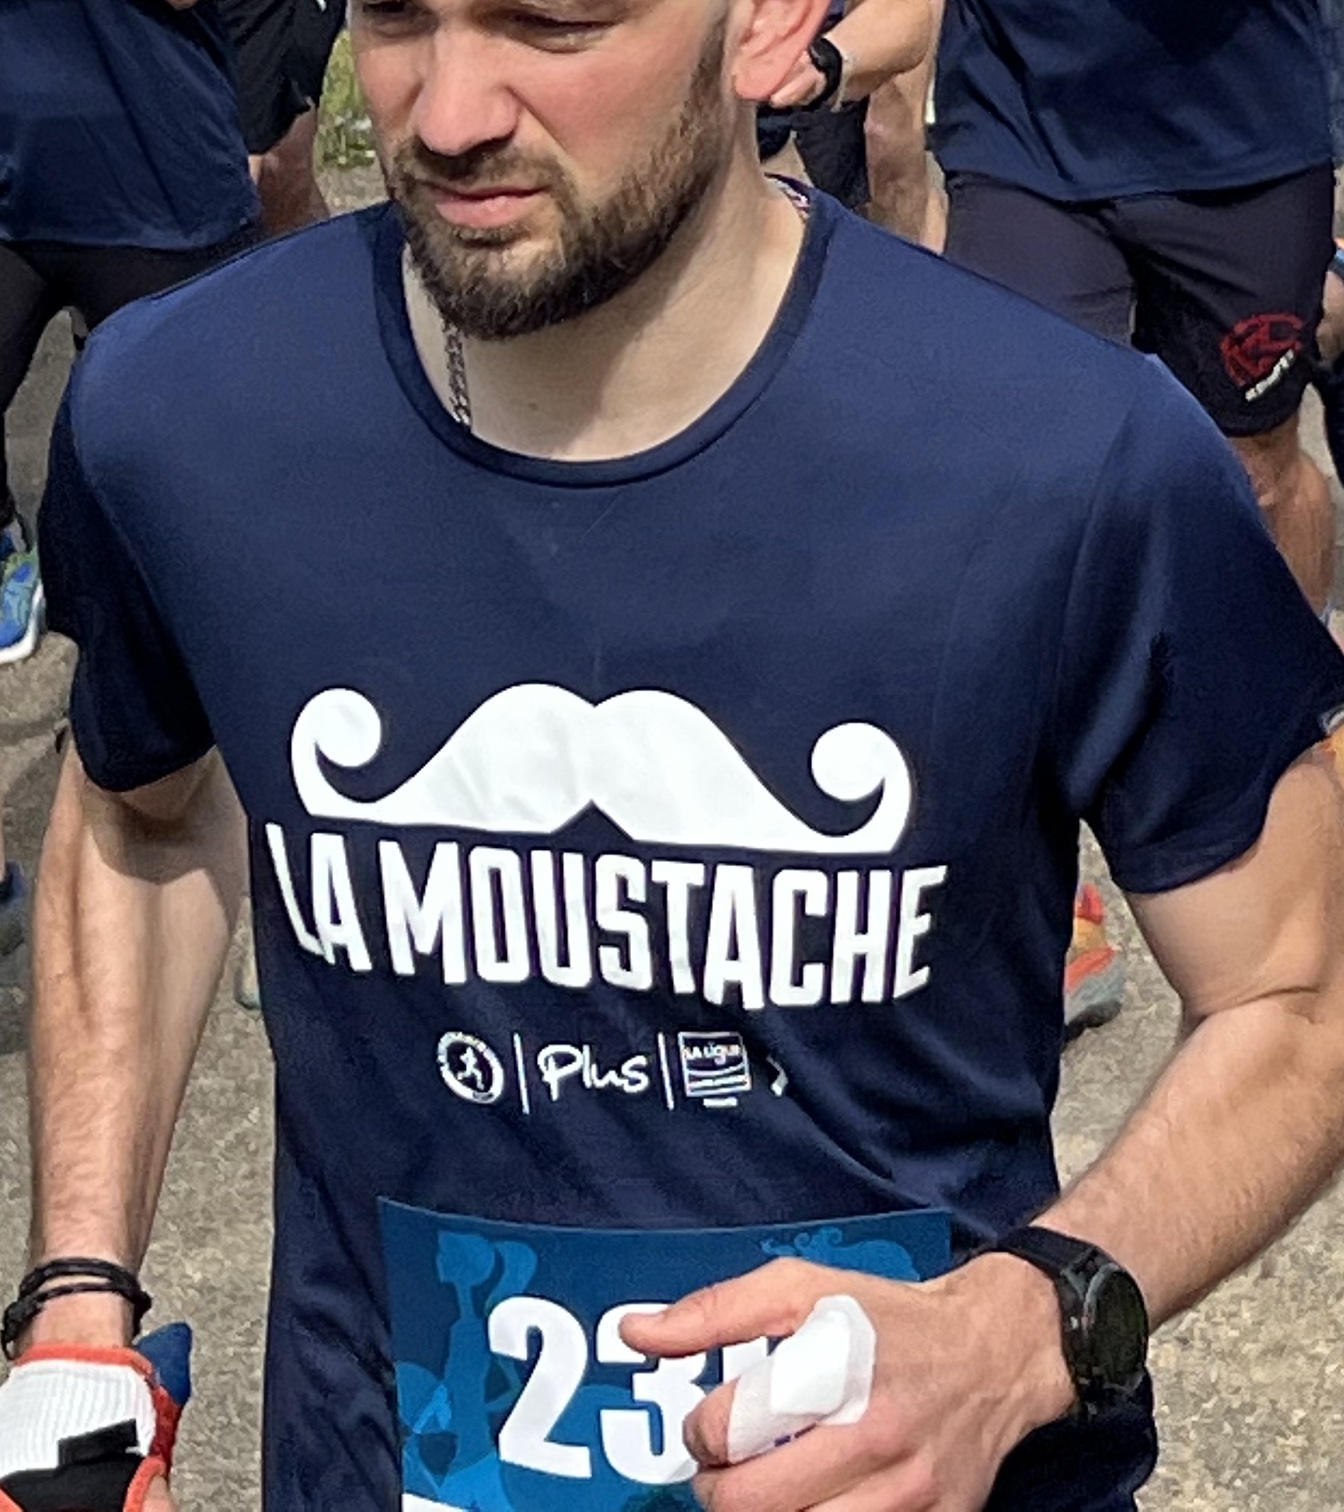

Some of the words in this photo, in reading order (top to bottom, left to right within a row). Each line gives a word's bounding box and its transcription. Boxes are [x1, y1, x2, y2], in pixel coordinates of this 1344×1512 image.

[266, 823, 373, 972] LA
[377, 840, 949, 1010] MOUSTACHE
[537, 1044, 652, 1102] Plus
[488, 1295, 771, 1485] 23
